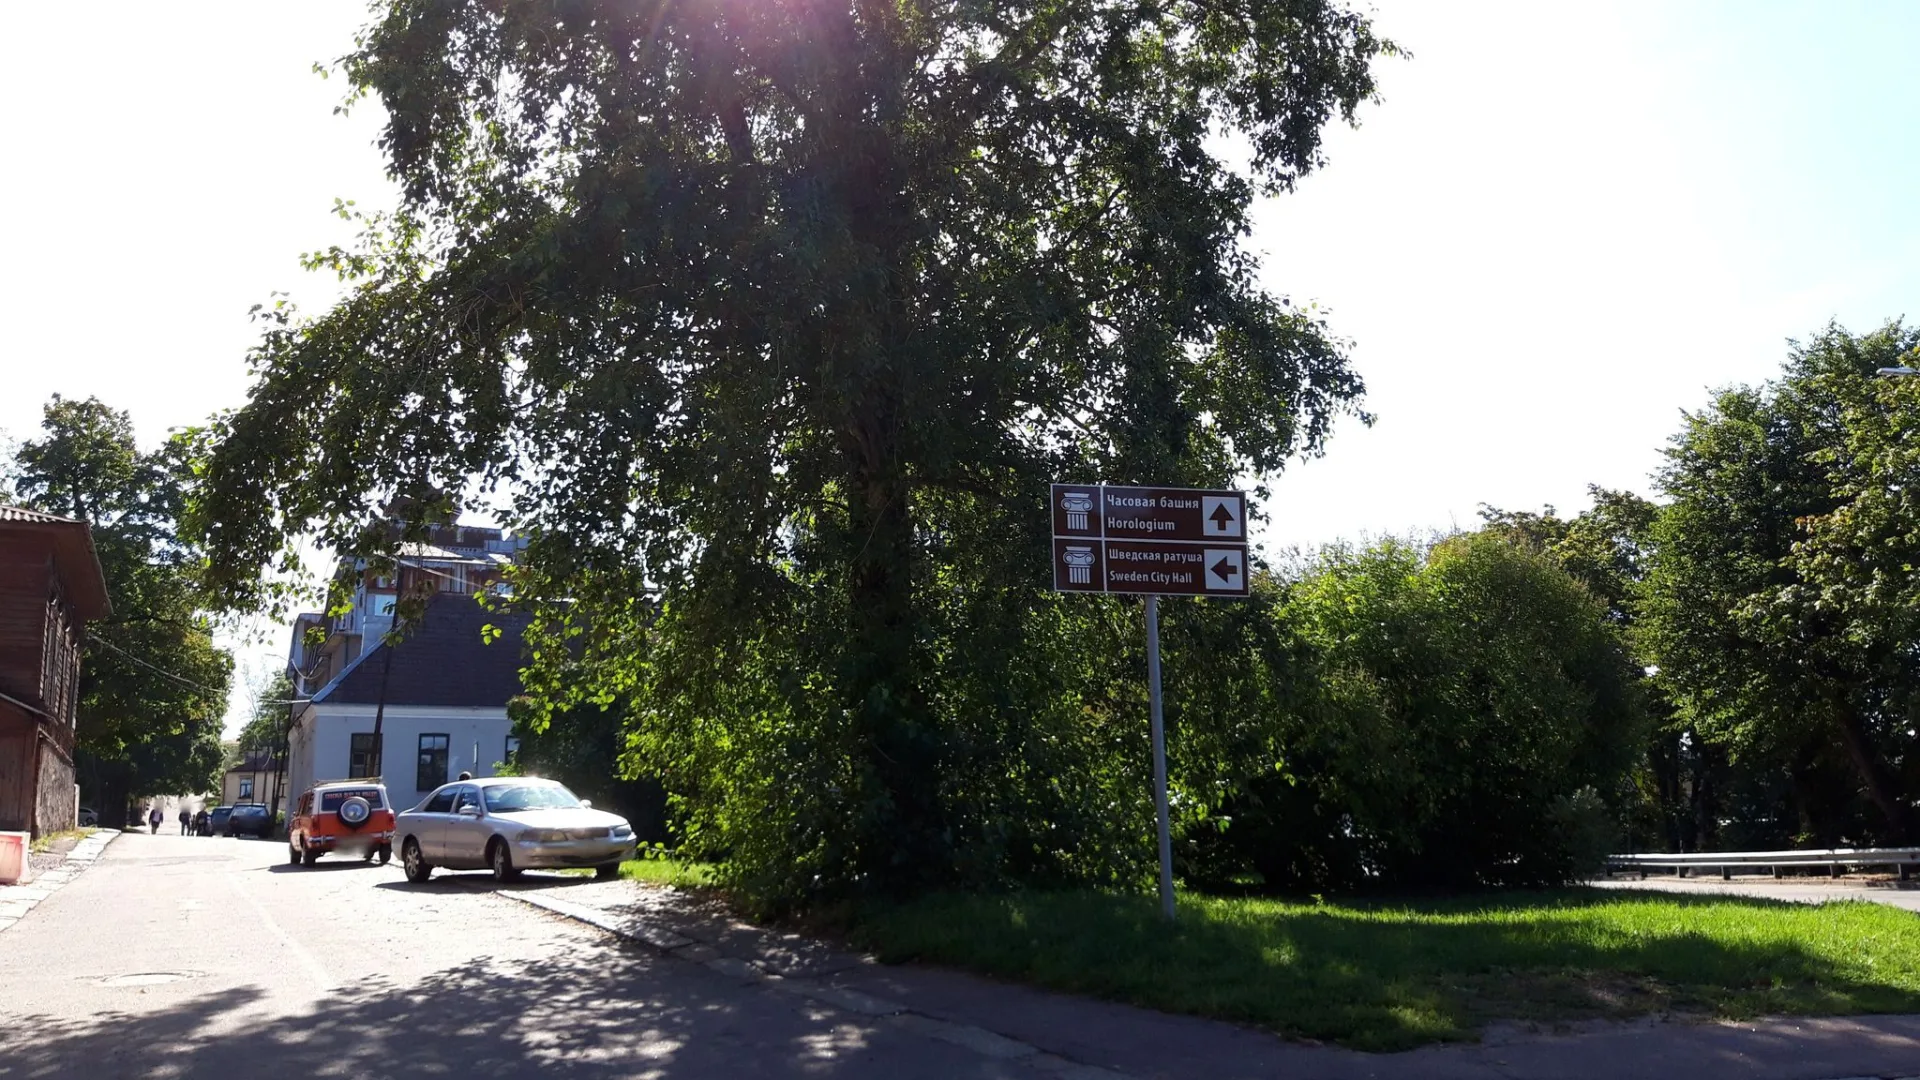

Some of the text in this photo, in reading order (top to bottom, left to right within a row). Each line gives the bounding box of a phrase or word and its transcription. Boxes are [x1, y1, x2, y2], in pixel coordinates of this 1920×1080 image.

[1107, 494, 1199, 509] Часовая башня
[1108, 517, 1175, 532] Horologium
[1108, 548, 1203, 564] Шведская ратуша
[1110, 570, 1192, 585] Sweden City Hall
